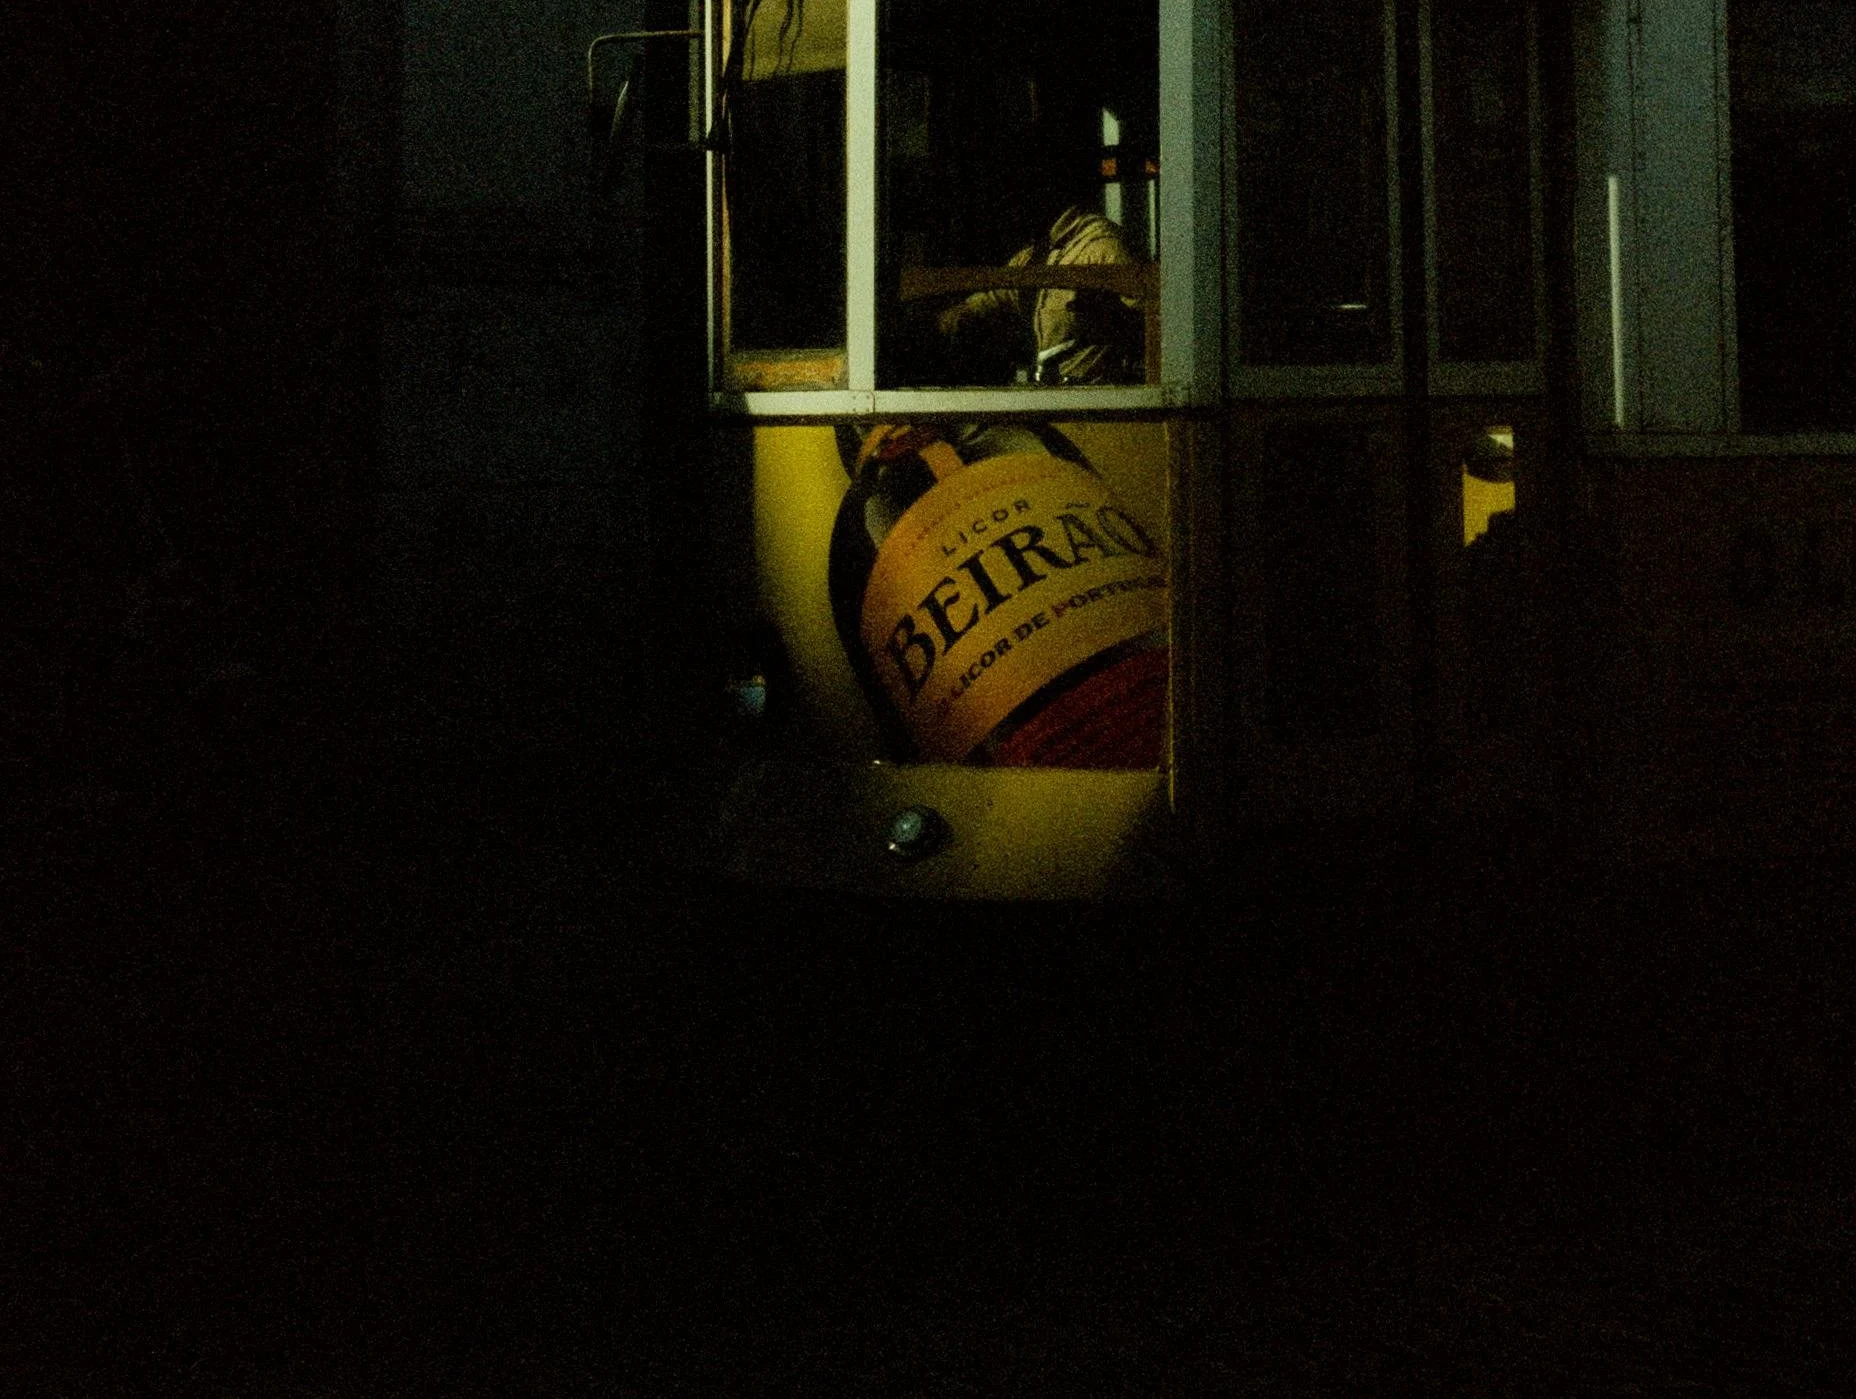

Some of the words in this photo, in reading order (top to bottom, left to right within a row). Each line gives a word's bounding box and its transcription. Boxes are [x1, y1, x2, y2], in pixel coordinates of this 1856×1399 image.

[941, 498, 1031, 557] LICOR
[886, 502, 1157, 705] BEIRÃO
[950, 637, 1013, 699] LICOR
[1013, 611, 1050, 643] DE
